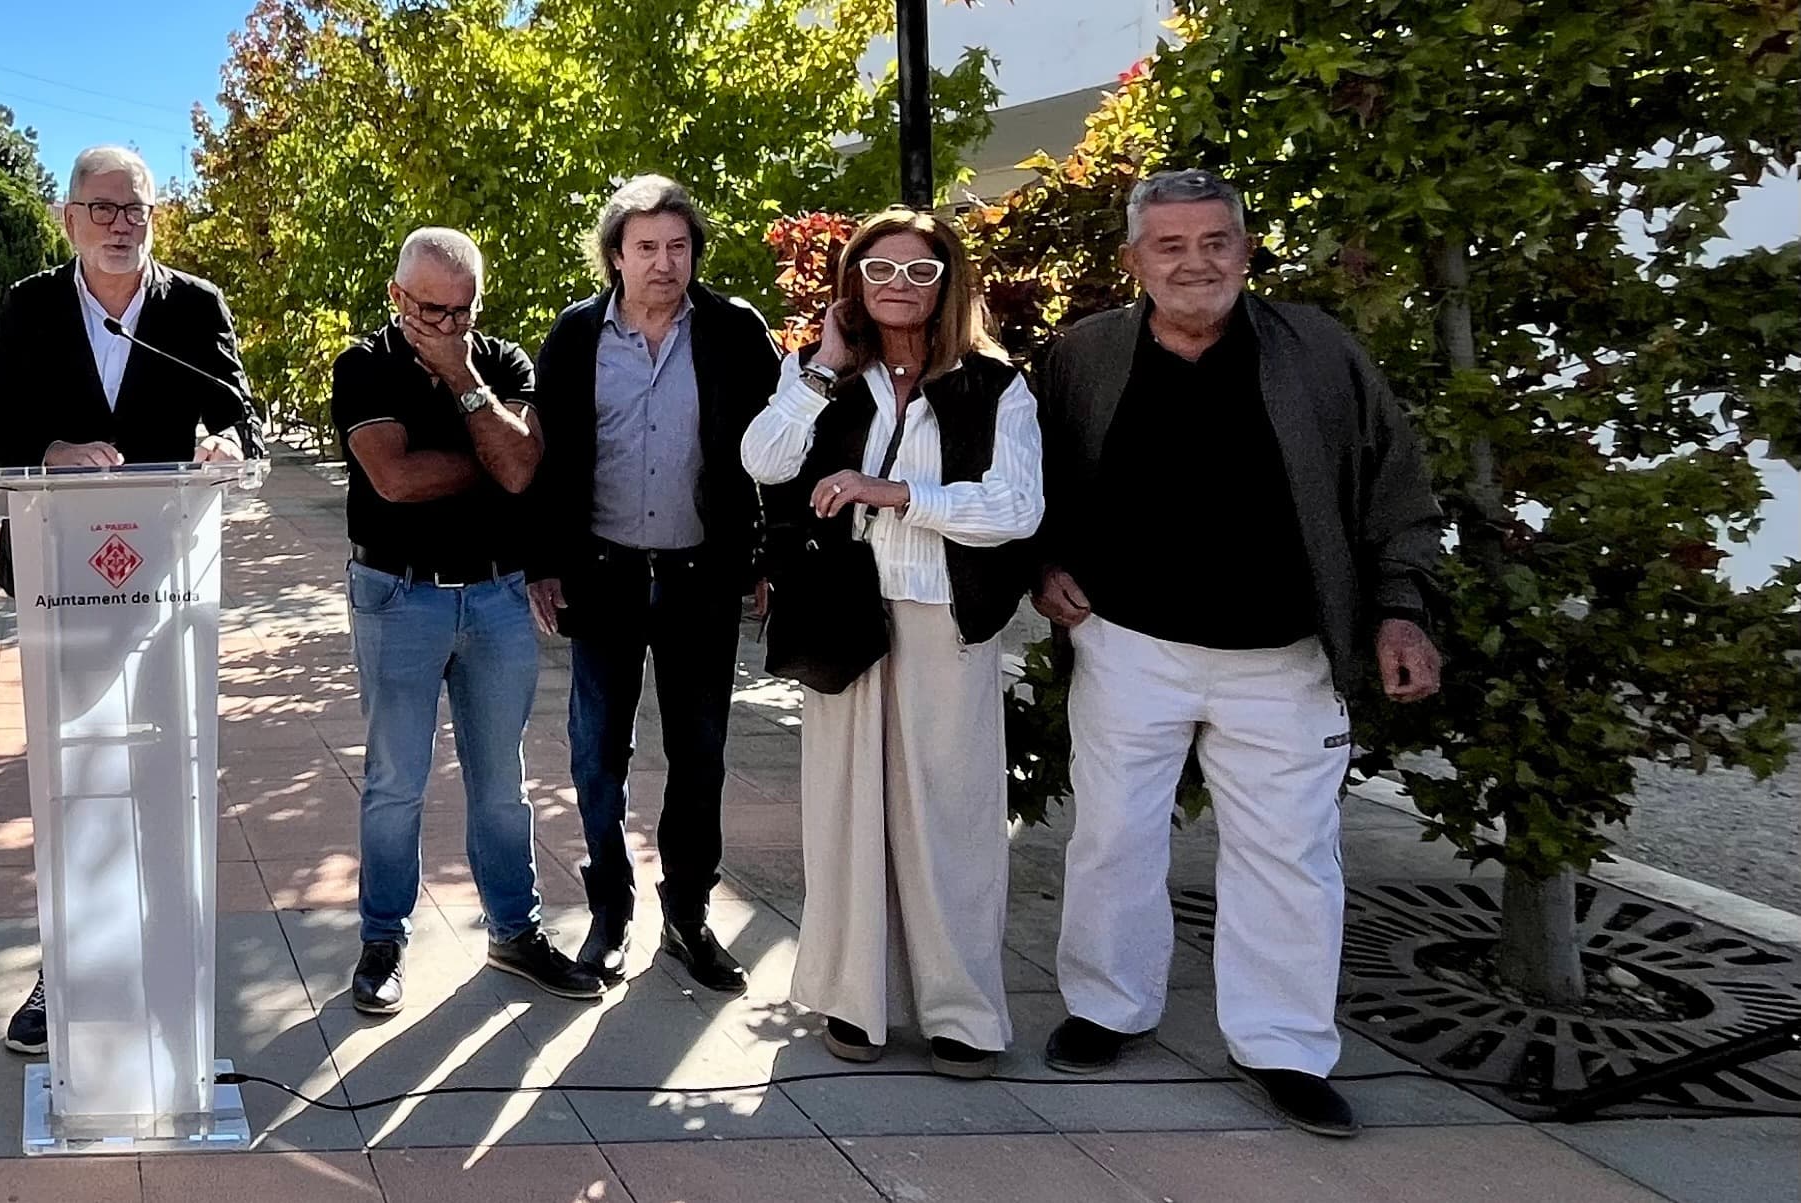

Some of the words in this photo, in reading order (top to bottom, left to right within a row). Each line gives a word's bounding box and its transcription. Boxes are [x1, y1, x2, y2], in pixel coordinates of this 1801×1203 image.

[36, 593, 126, 609] Ajuntament
[131, 591, 150, 603] de
[155, 590, 199, 602] Lleida
